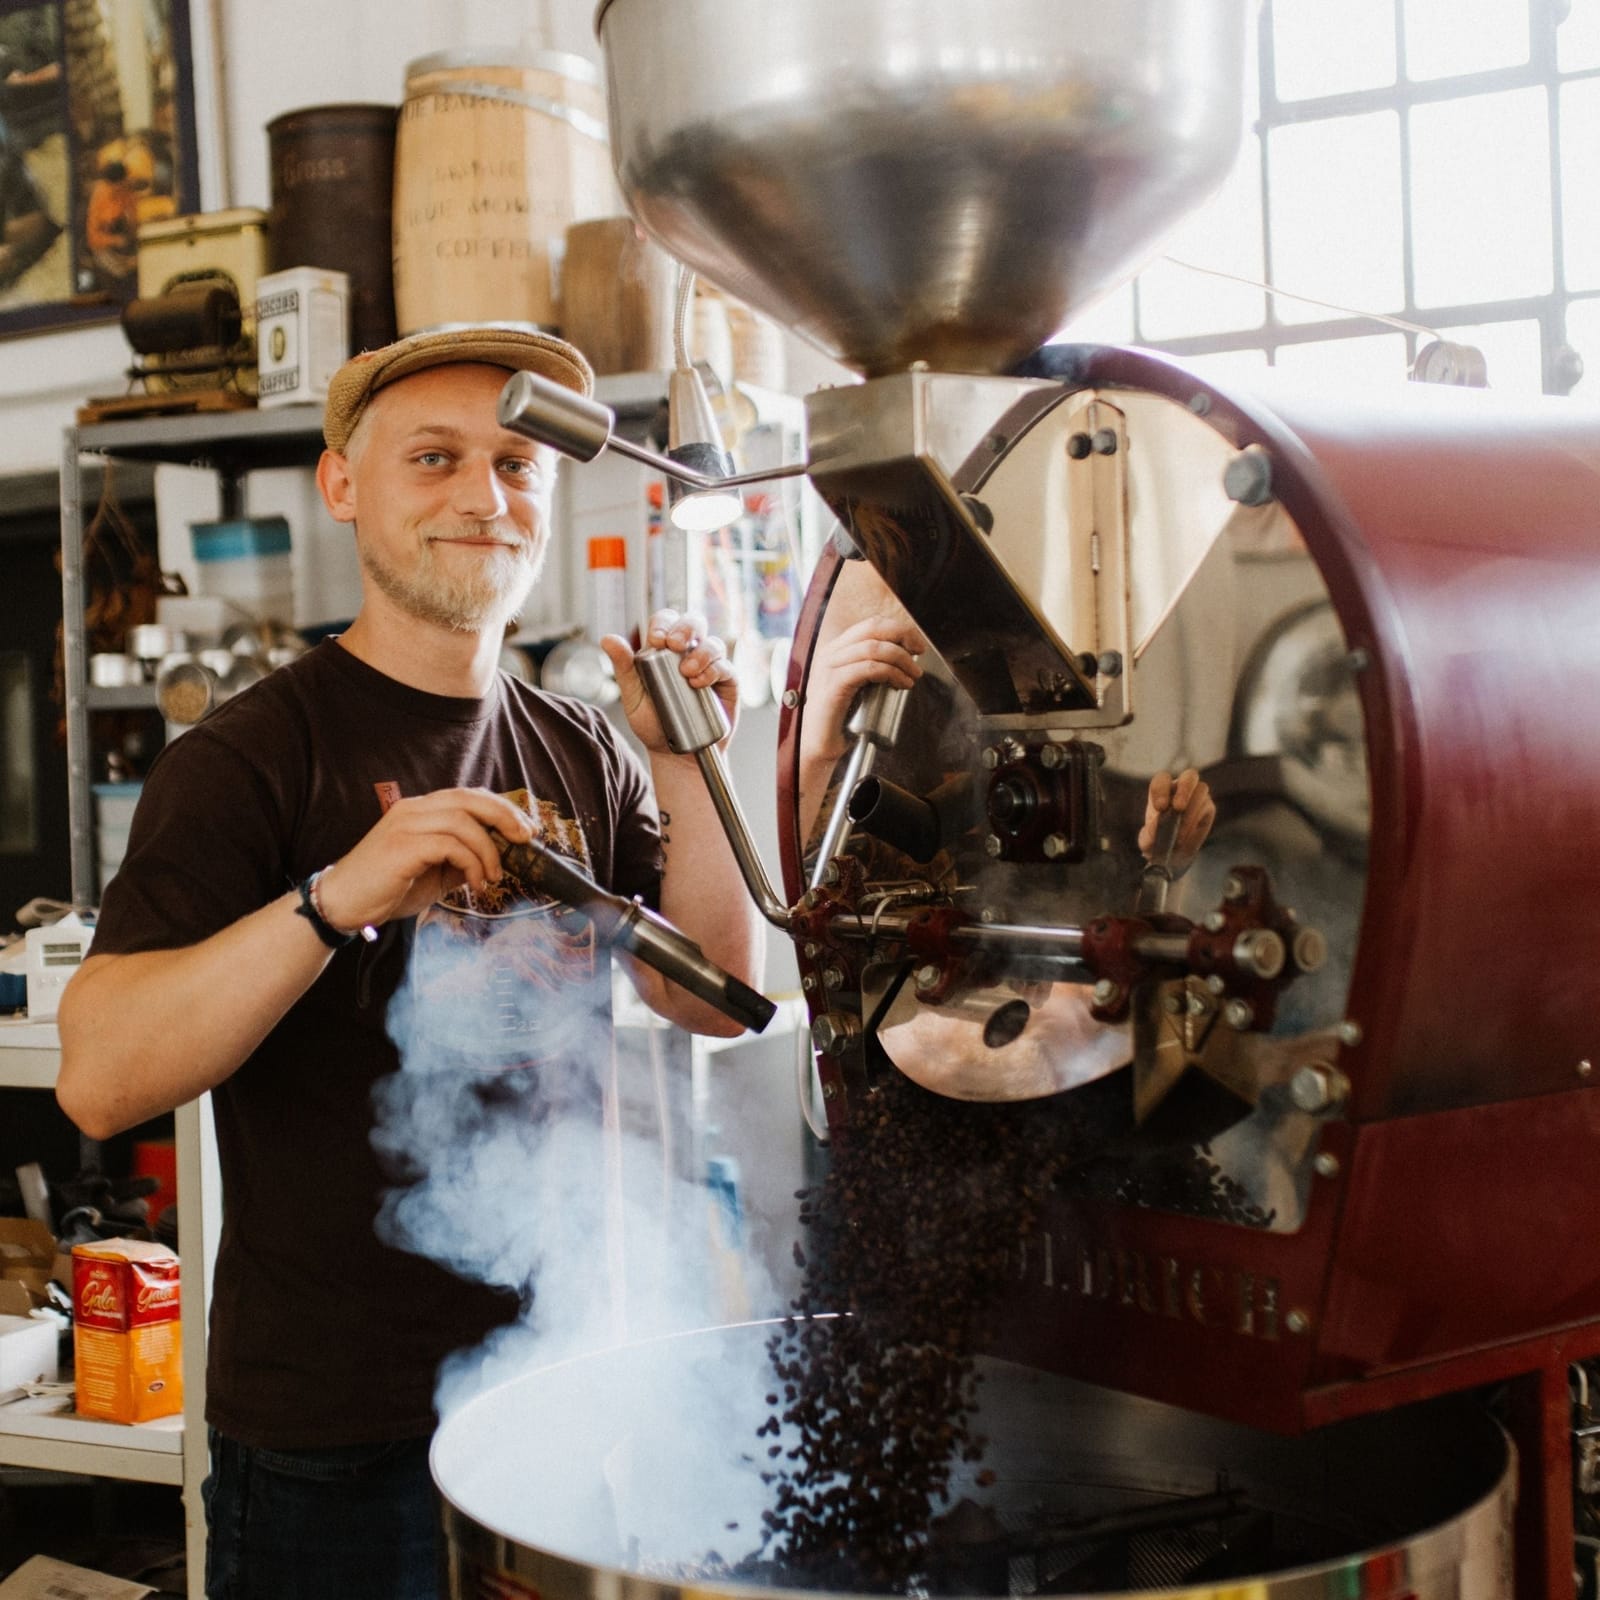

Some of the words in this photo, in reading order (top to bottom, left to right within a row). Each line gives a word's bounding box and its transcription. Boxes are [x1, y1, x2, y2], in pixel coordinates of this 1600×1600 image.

[257, 292, 296, 316] JACOBS
[259, 371, 296, 394] KAFFEE
[81, 1280, 117, 1317] Gala
